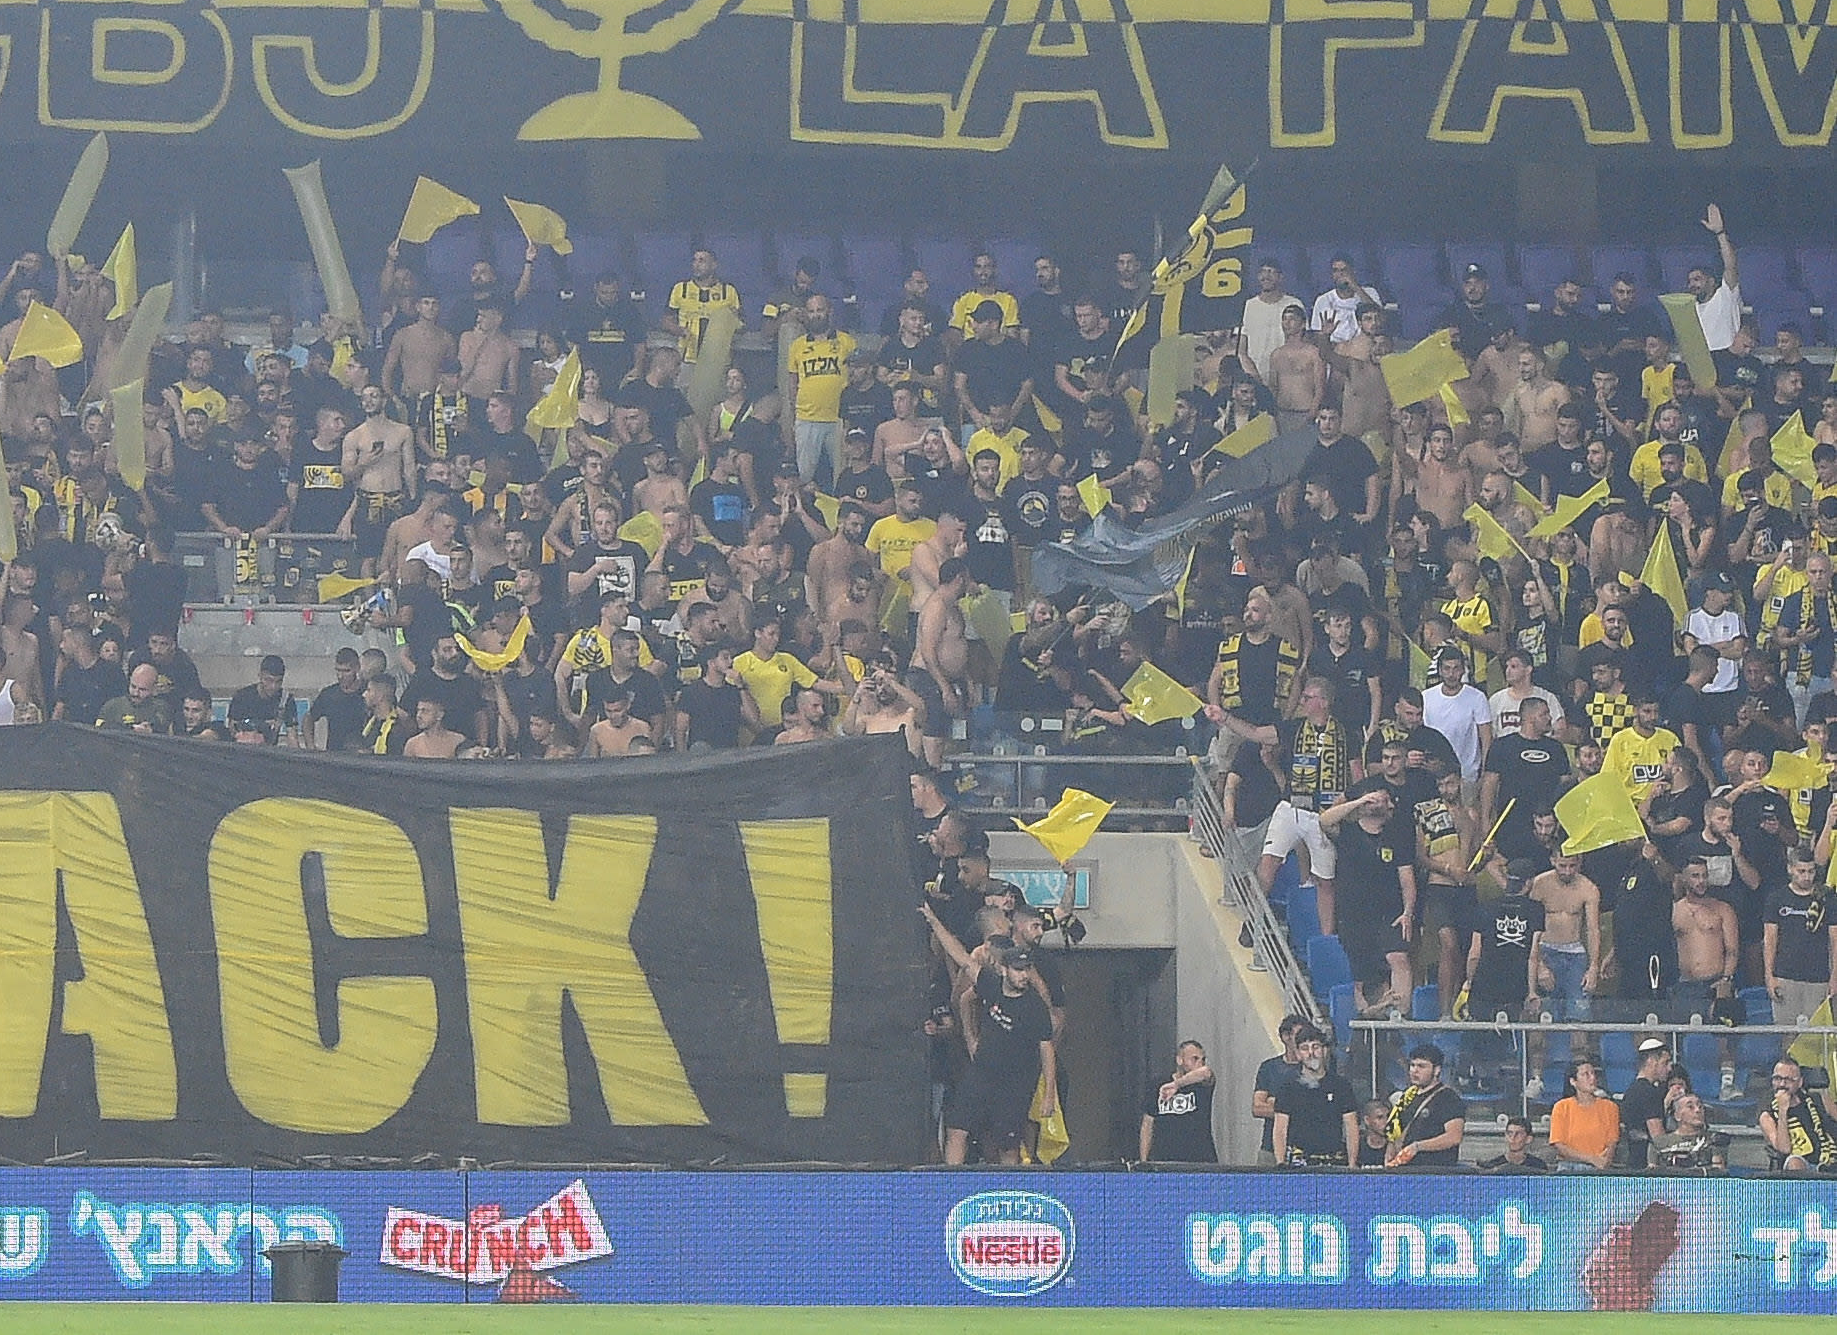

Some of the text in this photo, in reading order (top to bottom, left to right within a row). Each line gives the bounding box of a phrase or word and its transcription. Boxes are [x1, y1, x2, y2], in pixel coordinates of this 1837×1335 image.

[389, 1193, 595, 1275] CRUNCH
[1193, 1206, 1543, 1278] ליבת נוגט
